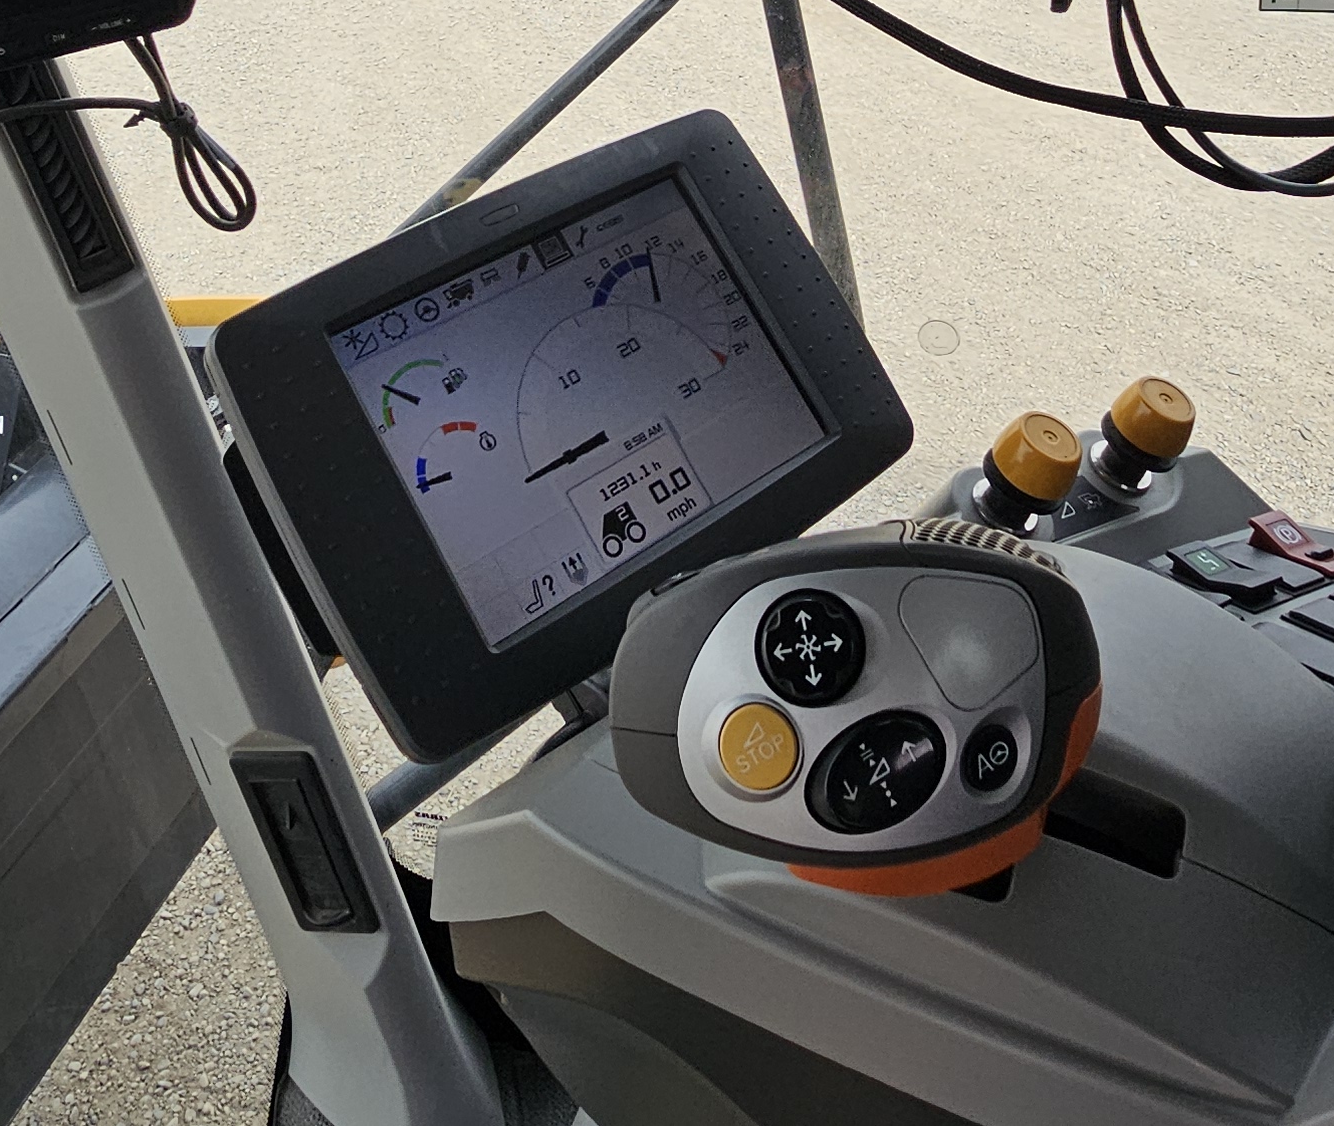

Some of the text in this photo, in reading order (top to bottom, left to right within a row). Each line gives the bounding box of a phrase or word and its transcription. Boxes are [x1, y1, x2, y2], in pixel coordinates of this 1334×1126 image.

[615, 243, 633, 259] 10
[644, 235, 663, 250] 12
[668, 238, 685, 253] 14
[599, 257, 611, 270] 8
[691, 250, 708, 266] 16
[711, 269, 728, 285] 18
[723, 289, 742, 306] 20
[732, 315, 749, 331] 22
[617, 337, 641, 359] 20
[732, 340, 750, 356] 24
[558, 369, 581, 390] 10
[677, 377, 702, 399] 30
[623, 423, 664, 451] 8:58 AM
[599, 460, 662, 502] 1231.1 h
[648, 466, 691, 505] 0.0
[615, 505, 630, 522] 2
[666, 496, 698, 522] mph
[735, 732, 787, 775] STOP
